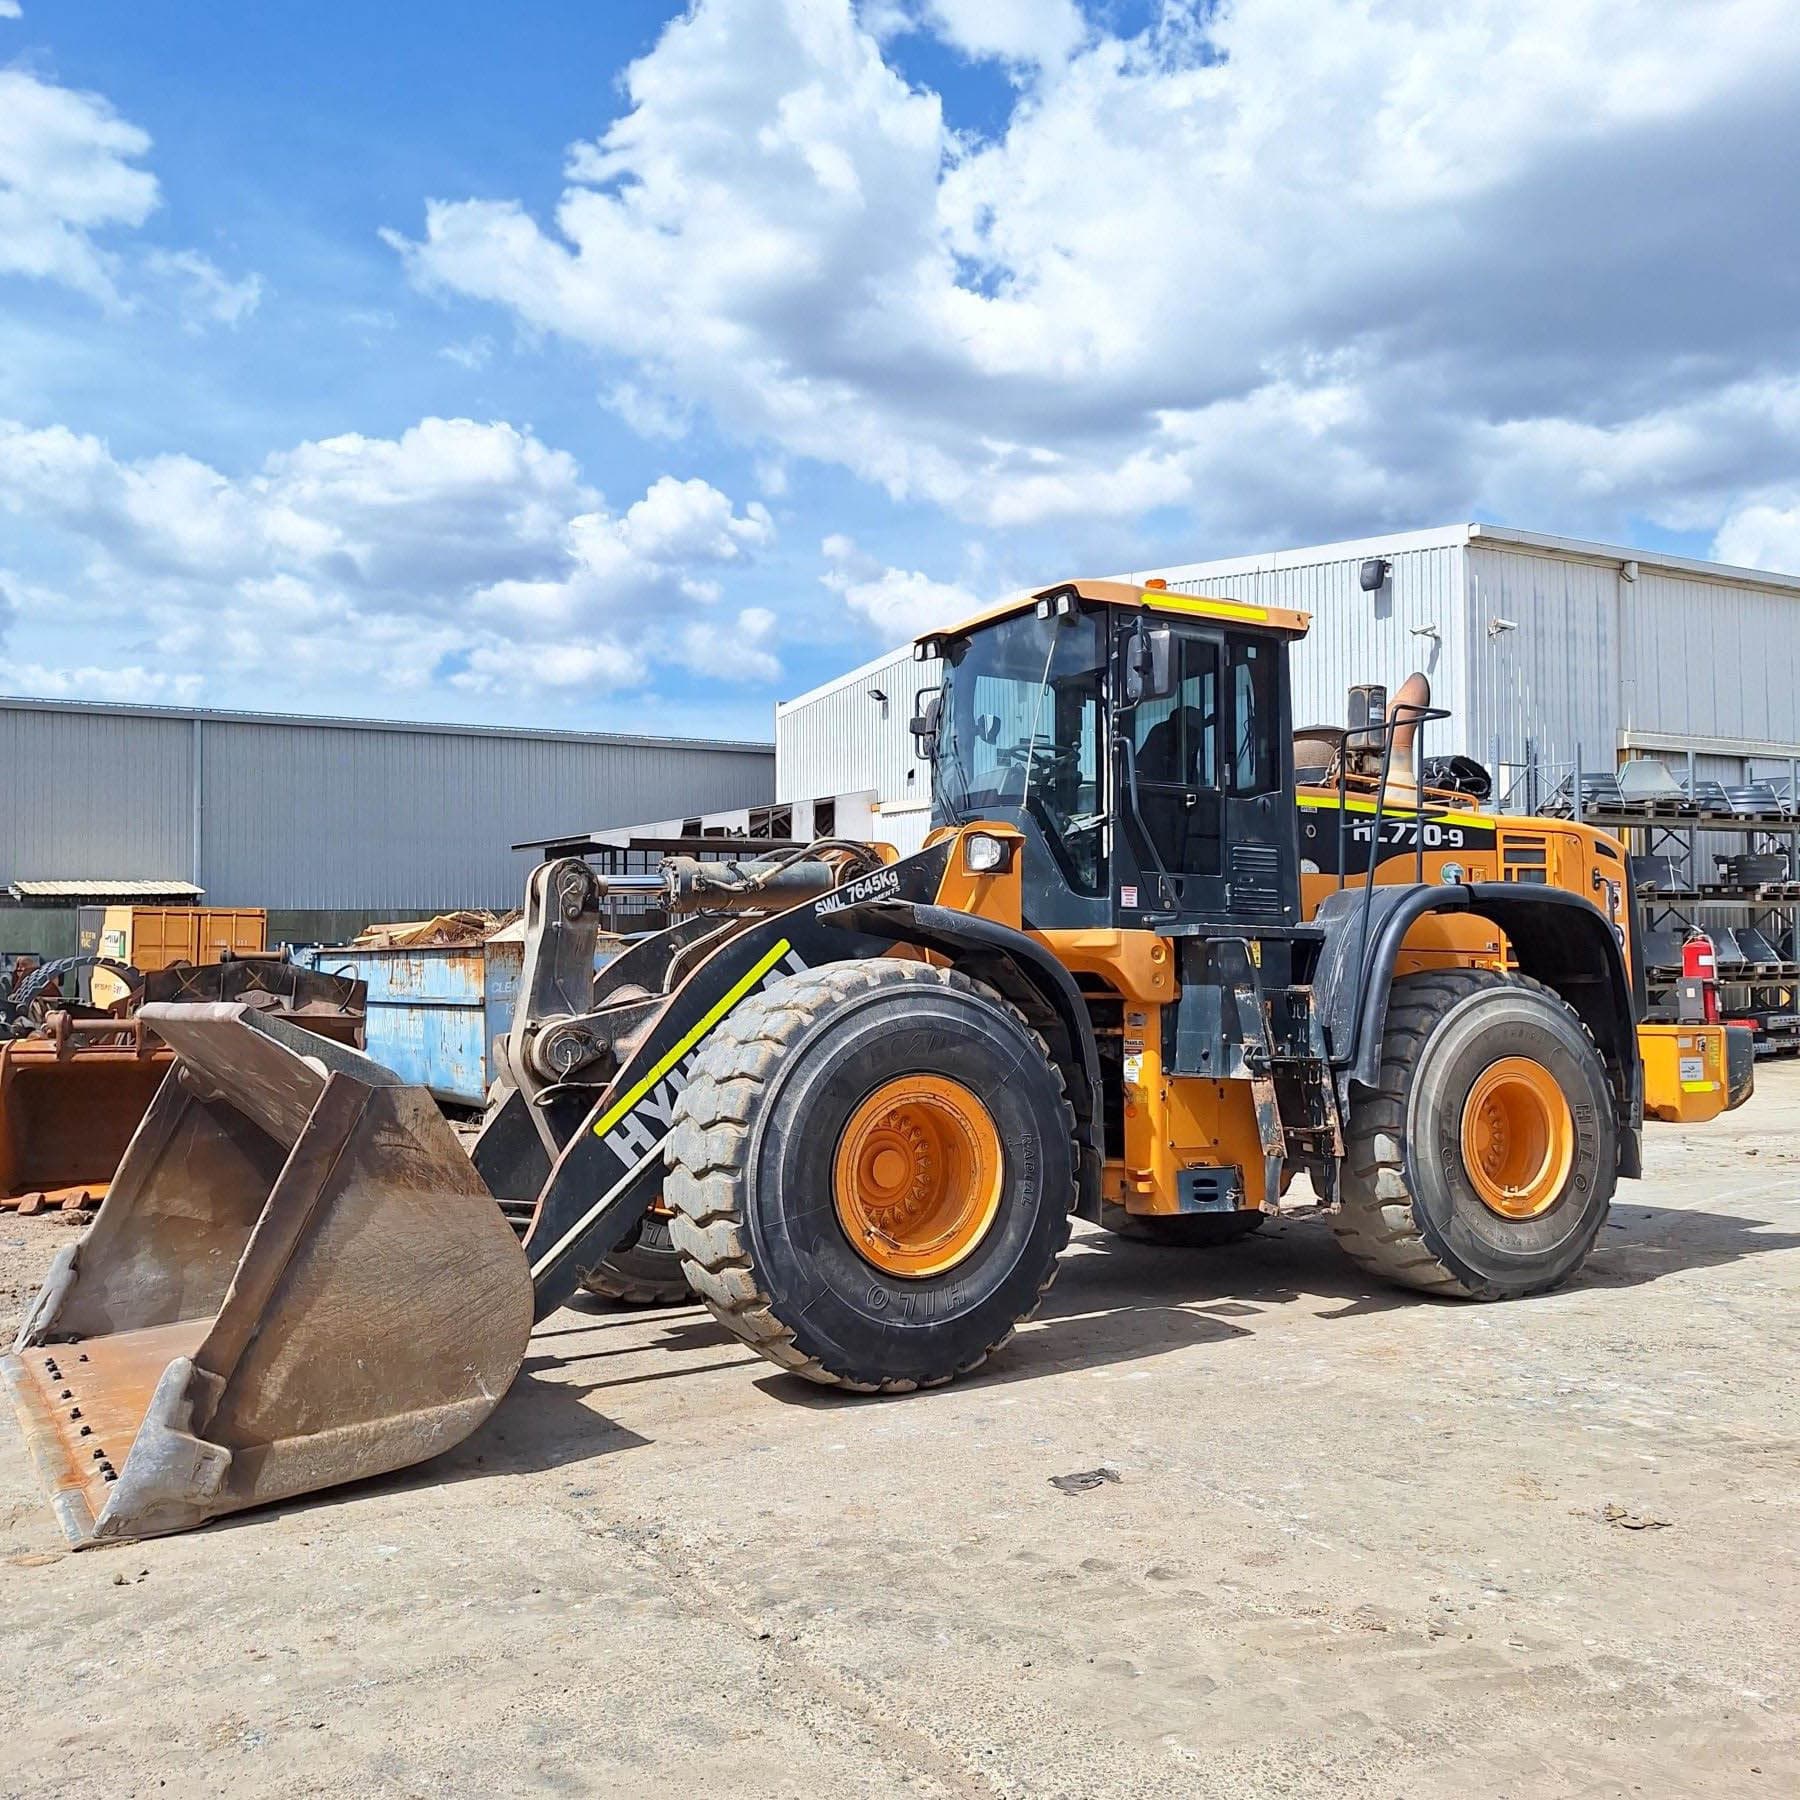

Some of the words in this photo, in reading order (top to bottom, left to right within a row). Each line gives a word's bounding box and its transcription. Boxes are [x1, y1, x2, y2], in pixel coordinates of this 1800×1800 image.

[815, 893, 845, 914] SWL
[847, 870, 899, 903] 7645Kg
[1020, 1132, 1035, 1206] RADIAL
[1575, 1103, 1595, 1193] HILO
[866, 1279, 967, 1317] HILO
